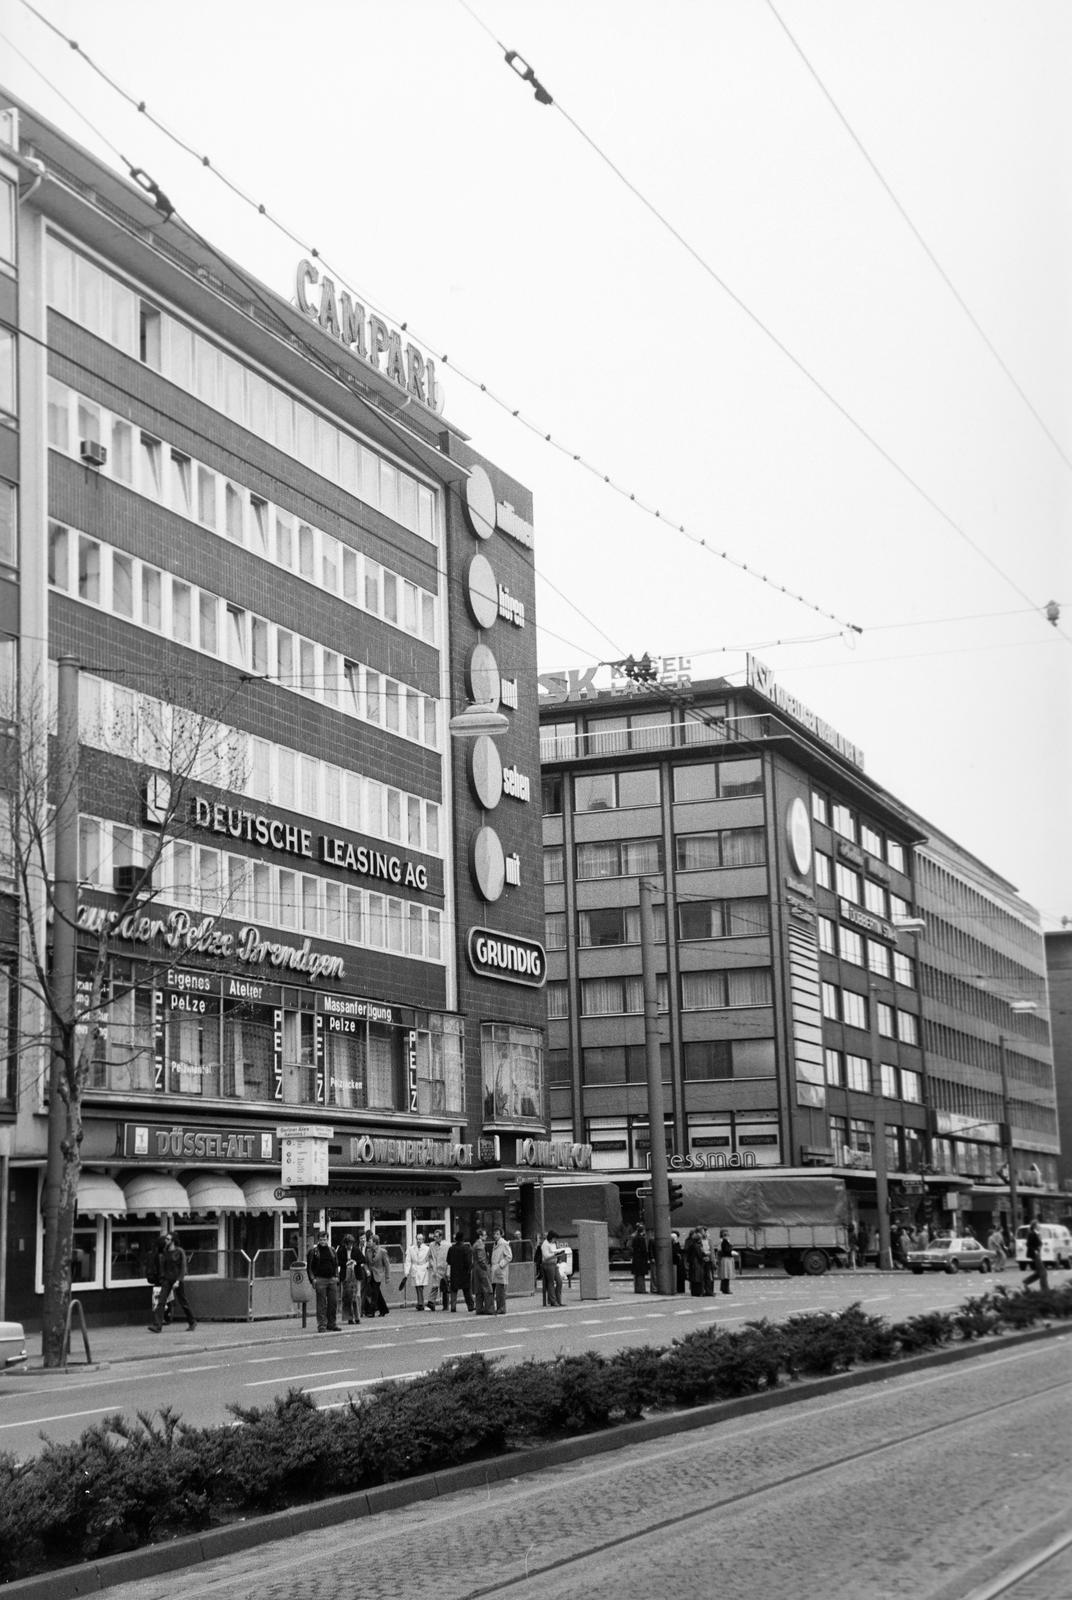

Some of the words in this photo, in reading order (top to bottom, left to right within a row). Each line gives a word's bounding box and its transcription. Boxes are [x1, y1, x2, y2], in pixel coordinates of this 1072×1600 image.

[297, 258, 437, 411] CAMPARI
[503, 765, 530, 802] sehen
[195, 796, 313, 858] DEUTSCHE
[321, 835, 402, 883] LEASING
[404, 861, 428, 890] AG
[506, 853, 521, 886] mit
[119, 902, 164, 941] der
[163, 910, 233, 957] Pelze
[237, 926, 346, 983] Brendgen
[476, 937, 541, 976] GRUNDIG
[167, 969, 211, 991] Eigenes
[229, 980, 262, 999] Atelier
[171, 994, 206, 1013] Pelze
[324, 996, 392, 1021] Massanfertigung
[329, 1016, 356, 1032] Pelze
[274, 1009, 283, 1099] PELZ
[409, 1030, 418, 1111] PELZ
[155, 1127, 256, 1158] DÜSSEL-ALT
[646, 1150, 756, 1170] essman
